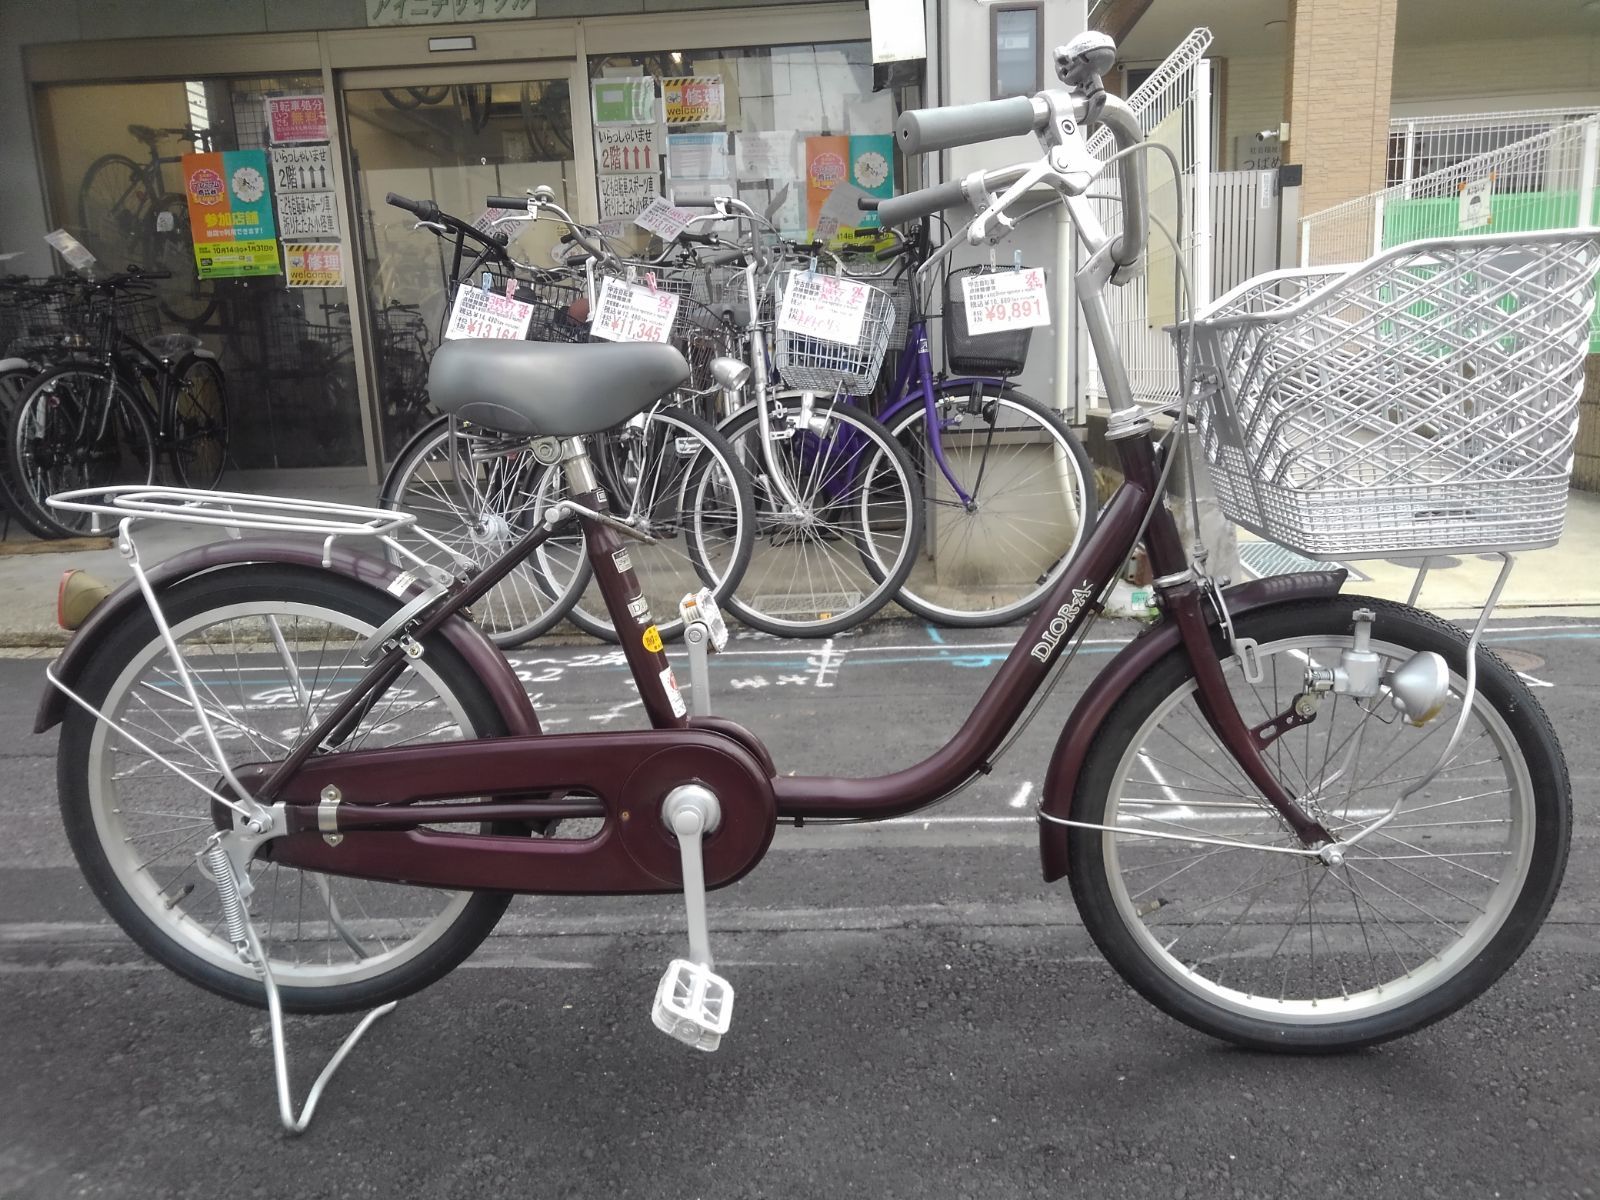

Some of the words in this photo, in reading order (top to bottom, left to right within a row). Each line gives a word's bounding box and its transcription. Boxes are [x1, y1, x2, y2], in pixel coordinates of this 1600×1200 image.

[271, 99, 321, 112] 自転車処分
[598, 128, 653, 143] いらっしゃいませ
[274, 149, 327, 163] いらっしゃいませ
[602, 145, 621, 170] 2階
[278, 164, 298, 190] 2階
[204, 211, 260, 227] 参加店舗
[985, 299, 1041, 322] ¥9,891
[611, 315, 662, 342] ¥11,345
[1031, 579, 1094, 663] DIORA
